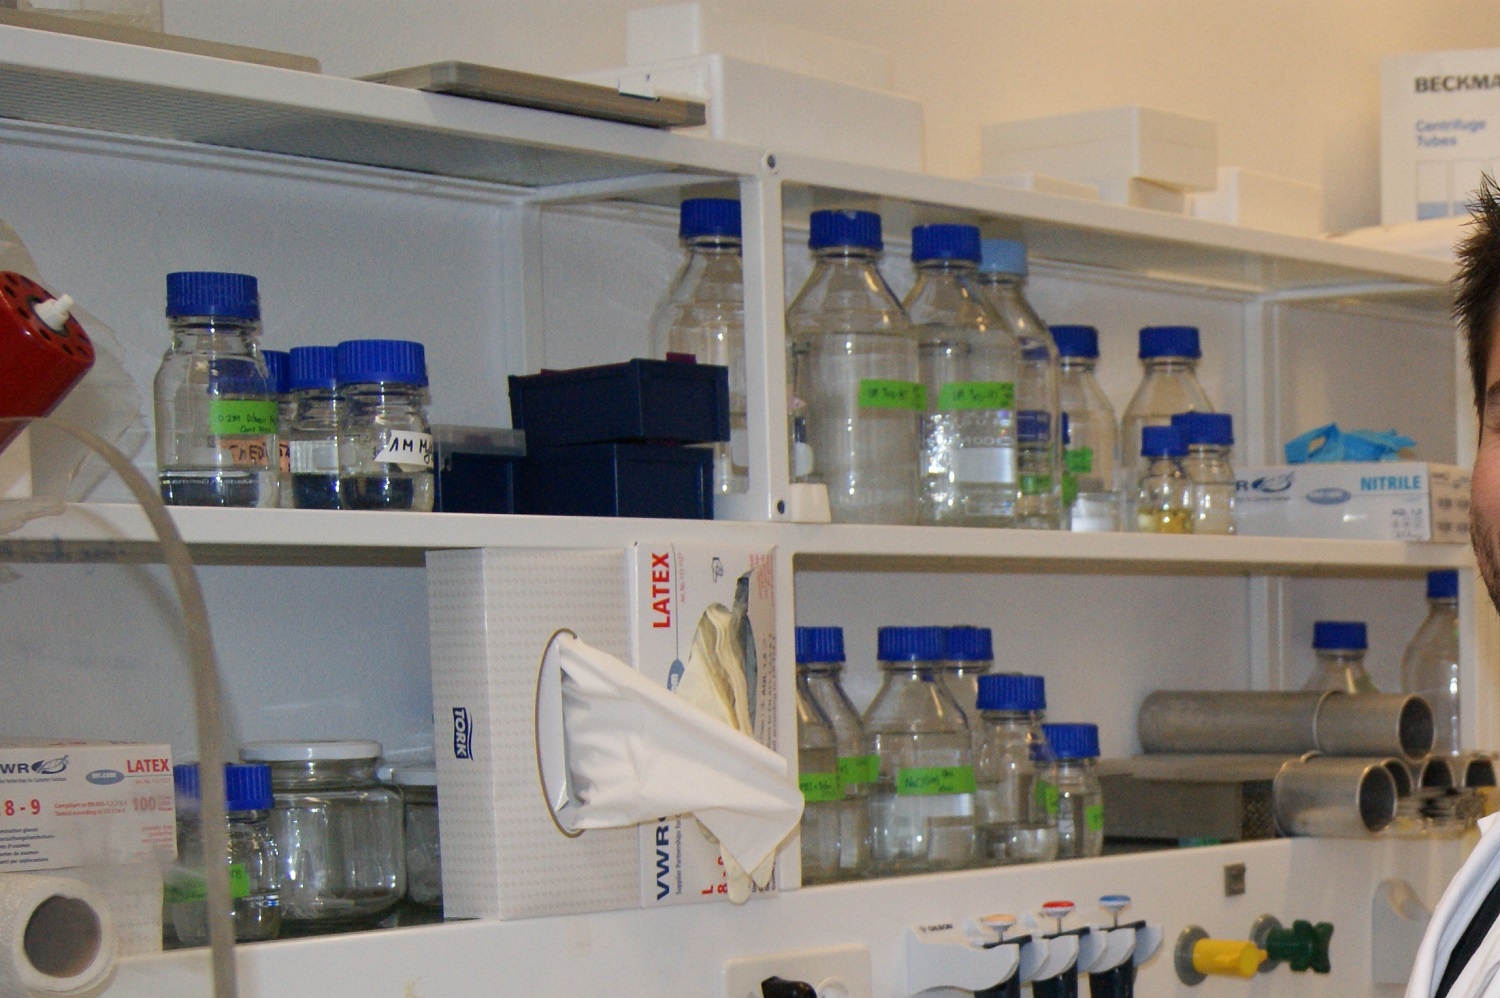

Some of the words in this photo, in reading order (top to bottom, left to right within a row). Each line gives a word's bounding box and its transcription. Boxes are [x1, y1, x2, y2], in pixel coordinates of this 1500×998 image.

[1415, 118, 1486, 133] Centrifuge
[1416, 135, 1457, 147] Tubes
[1360, 475, 1421, 491] NITRILE
[652, 552, 671, 629] LATEX
[455, 708, 469, 759] TORK
[0, 763, 29, 774] WR
[127, 758, 170, 773] LATEX
[4, 800, 15, 816] 8
[31, 799, 41, 815] 9
[132, 797, 156, 812] 100
[656, 825, 670, 900] VWR
